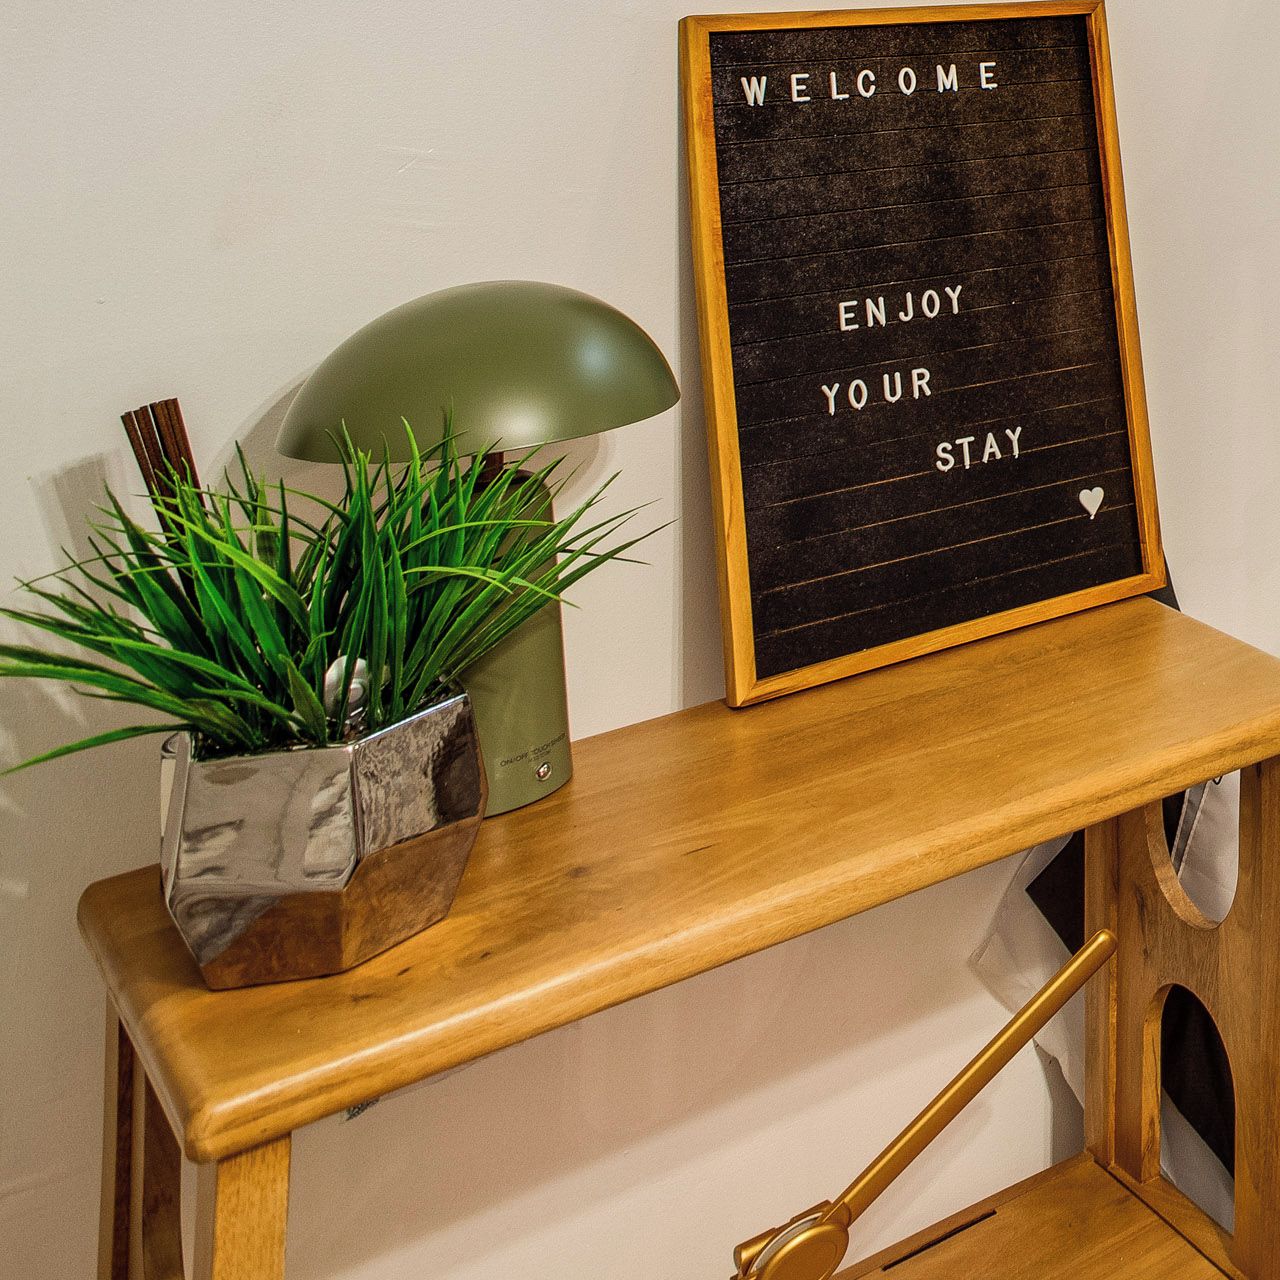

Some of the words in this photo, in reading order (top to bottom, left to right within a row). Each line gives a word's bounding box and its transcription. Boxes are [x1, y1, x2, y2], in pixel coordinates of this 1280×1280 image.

[741, 62, 998, 106] WELCOME
[838, 285, 962, 331] ENJOY
[821, 368, 931, 416] YOUR
[936, 426, 1022, 472] STAY
